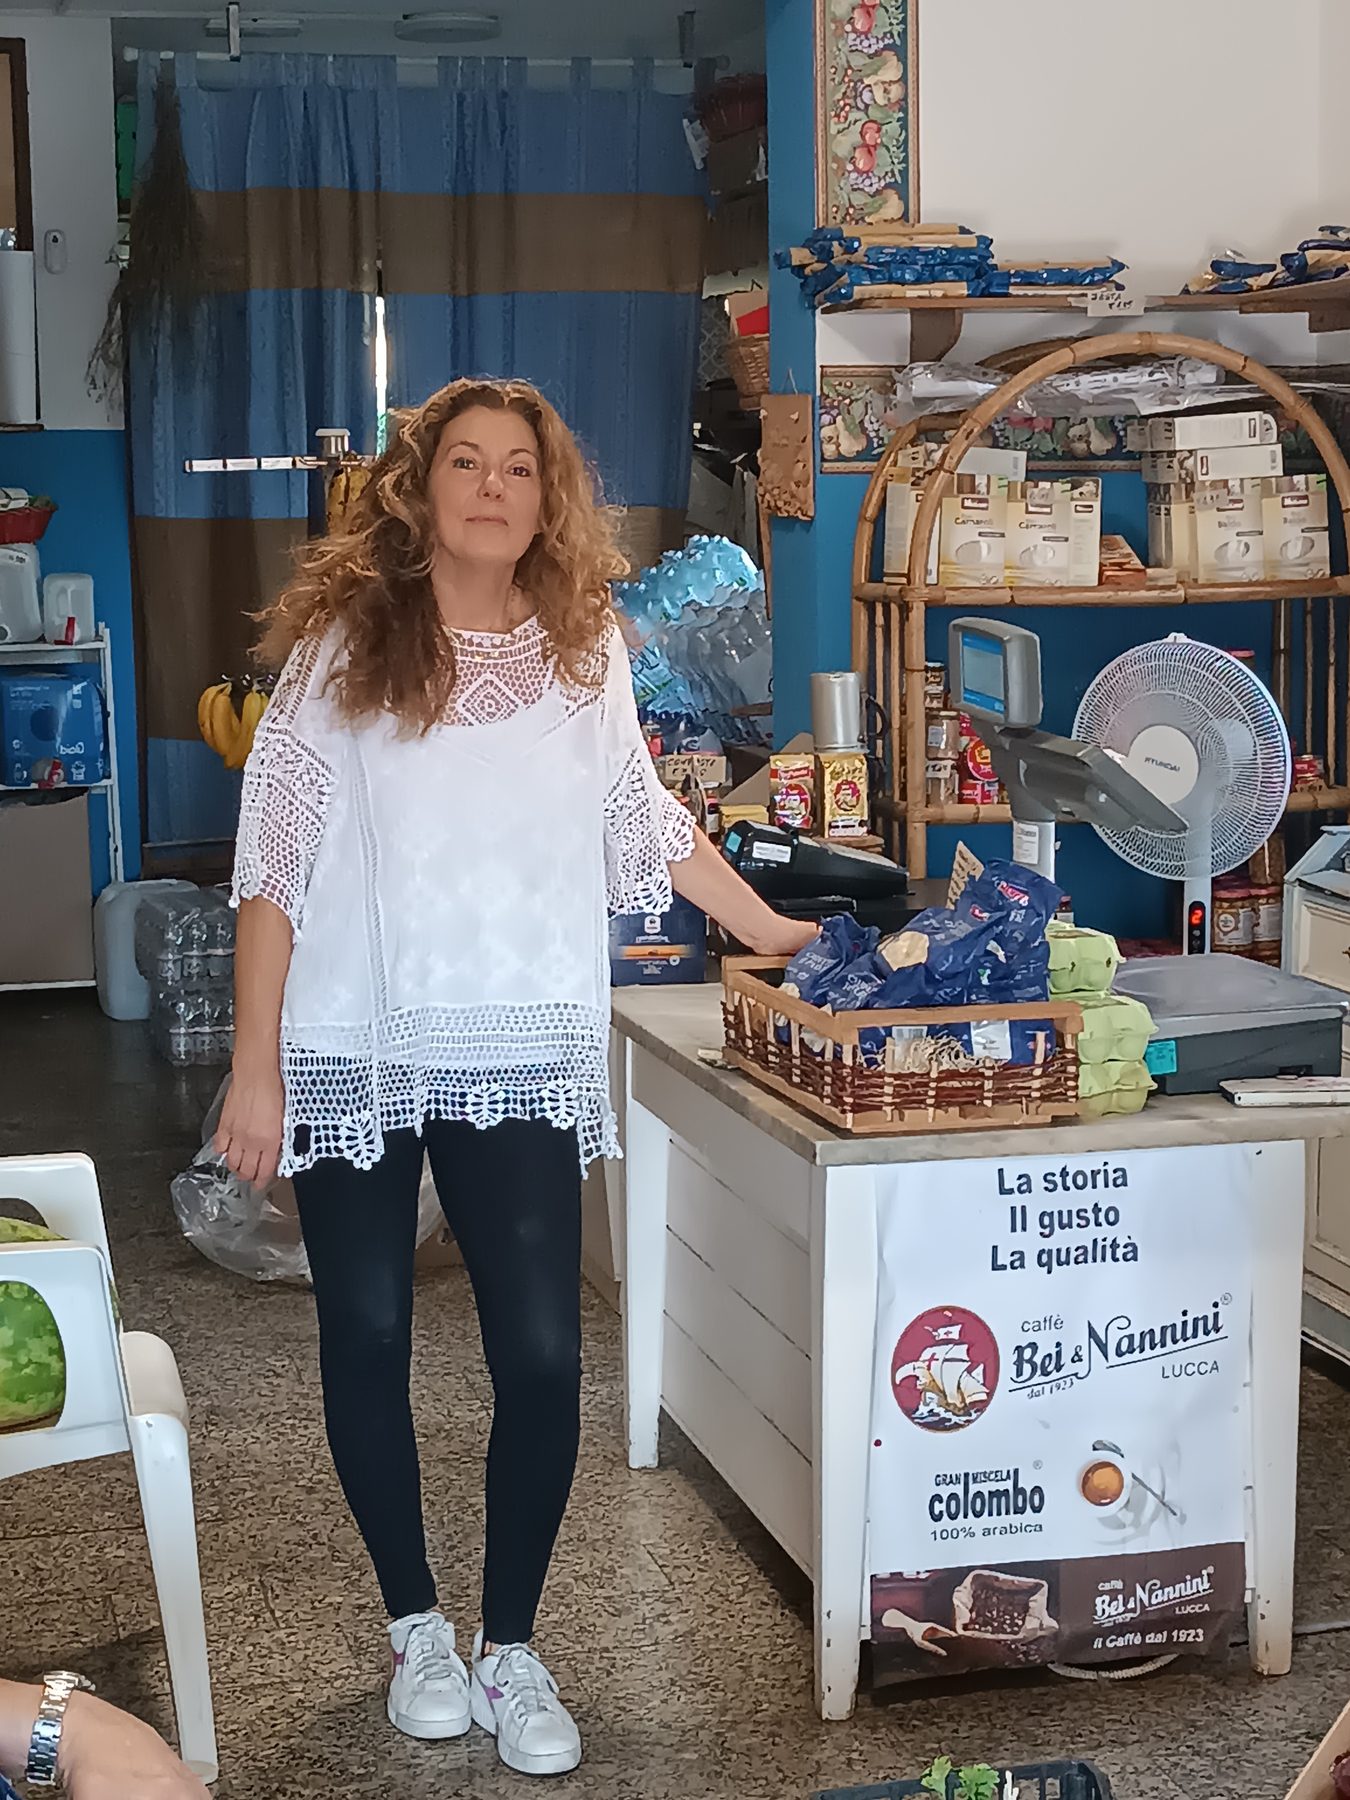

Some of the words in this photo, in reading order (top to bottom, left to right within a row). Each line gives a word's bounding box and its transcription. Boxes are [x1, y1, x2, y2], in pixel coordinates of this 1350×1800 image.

[1190, 907, 1203, 926] 2
[997, 1167, 1033, 1196] La
[1042, 1161, 1129, 1193] storia
[1010, 1204, 1028, 1233] Il
[1038, 1201, 1121, 1239] gusto
[991, 1244, 1026, 1272] La
[1036, 1234, 1139, 1275] qualità
[1009, 1340, 1066, 1384] Bei
[1070, 1344, 1084, 1364] &
[1086, 1300, 1224, 1372] Nannini
[1161, 1359, 1220, 1379] LUCCA
[1026, 1385, 1045, 1400] dal
[1049, 1377, 1075, 1395] 1923
[934, 1471, 962, 1487] GRAN
[928, 1467, 1046, 1523] colombo
[930, 1526, 976, 1542] 100%
[981, 1521, 1043, 1537] arabica
[1135, 1568, 1211, 1614] Nannini
[1174, 1603, 1211, 1615] LUCCA
[1145, 1629, 1169, 1645] dal
[1171, 1627, 1205, 1643] 1923
